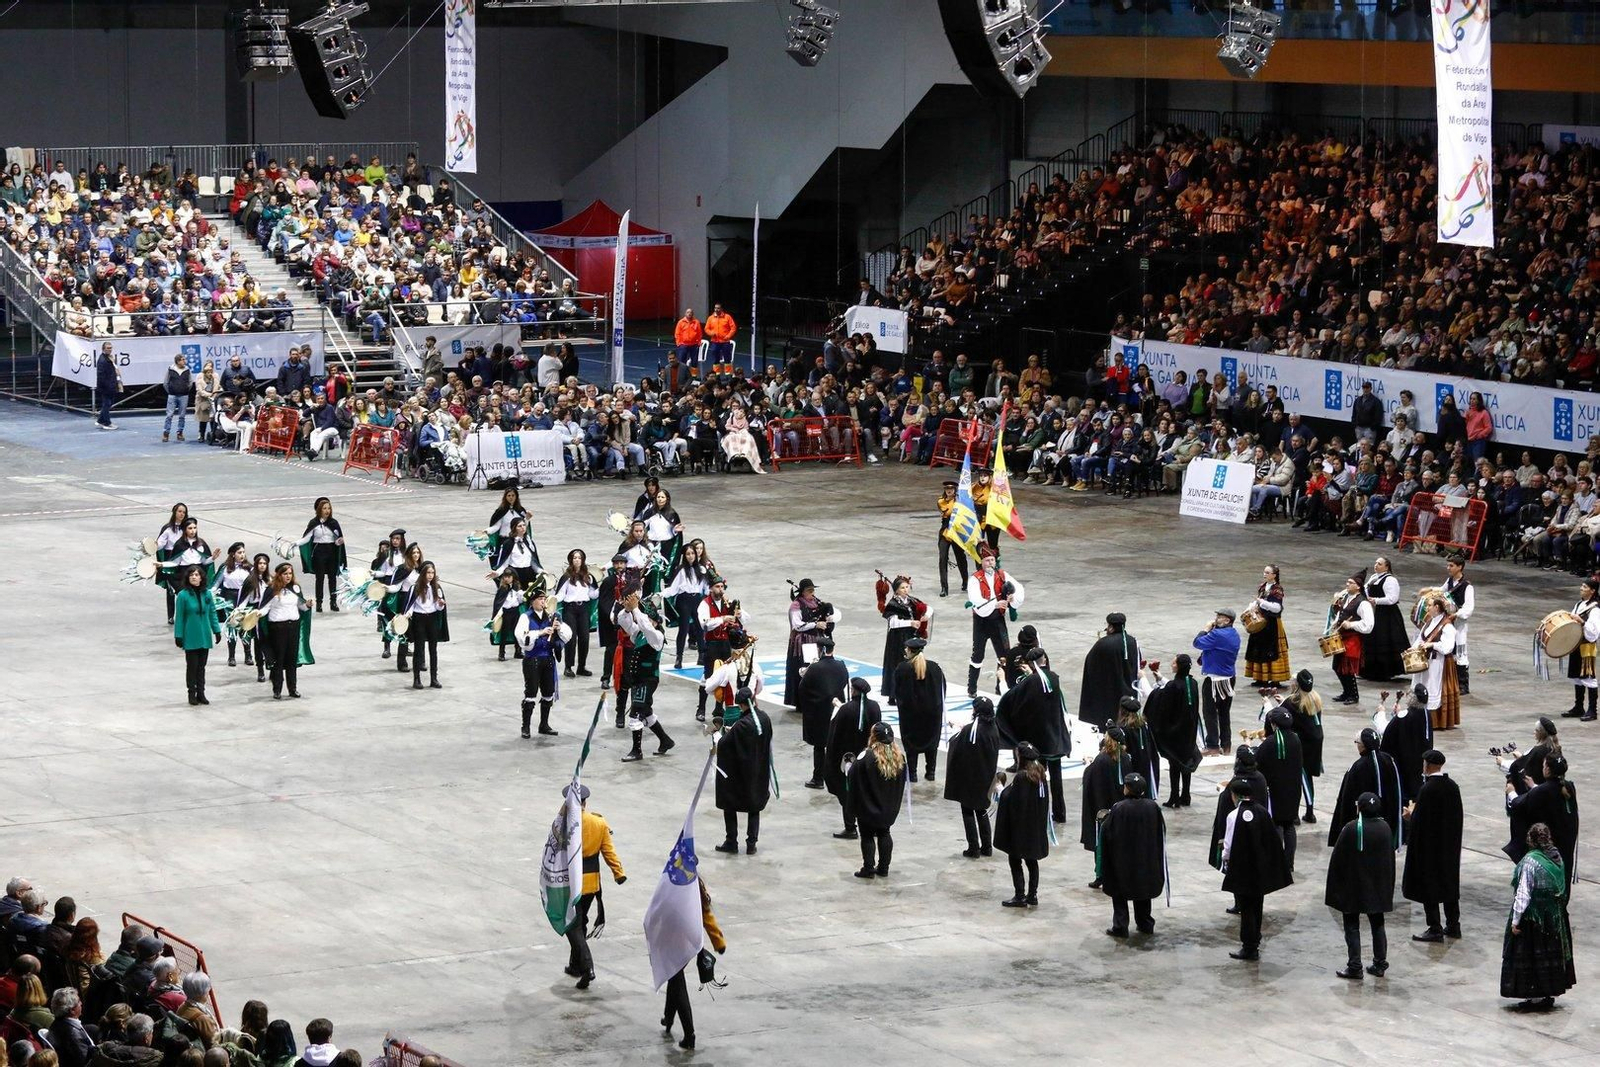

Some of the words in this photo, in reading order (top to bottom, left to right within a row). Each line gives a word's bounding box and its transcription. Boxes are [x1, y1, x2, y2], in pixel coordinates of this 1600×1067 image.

[1461, 99, 1472, 108] da
[1462, 132, 1473, 142] de
[205, 345, 248, 357] XUNTA
[1142, 351, 1177, 367] XUNTA
[520, 459, 555, 468] GALICIA
[1187, 487, 1210, 499] XUNTA
[1210, 491, 1219, 500] DE
[1218, 492, 1244, 504] GALICIA
